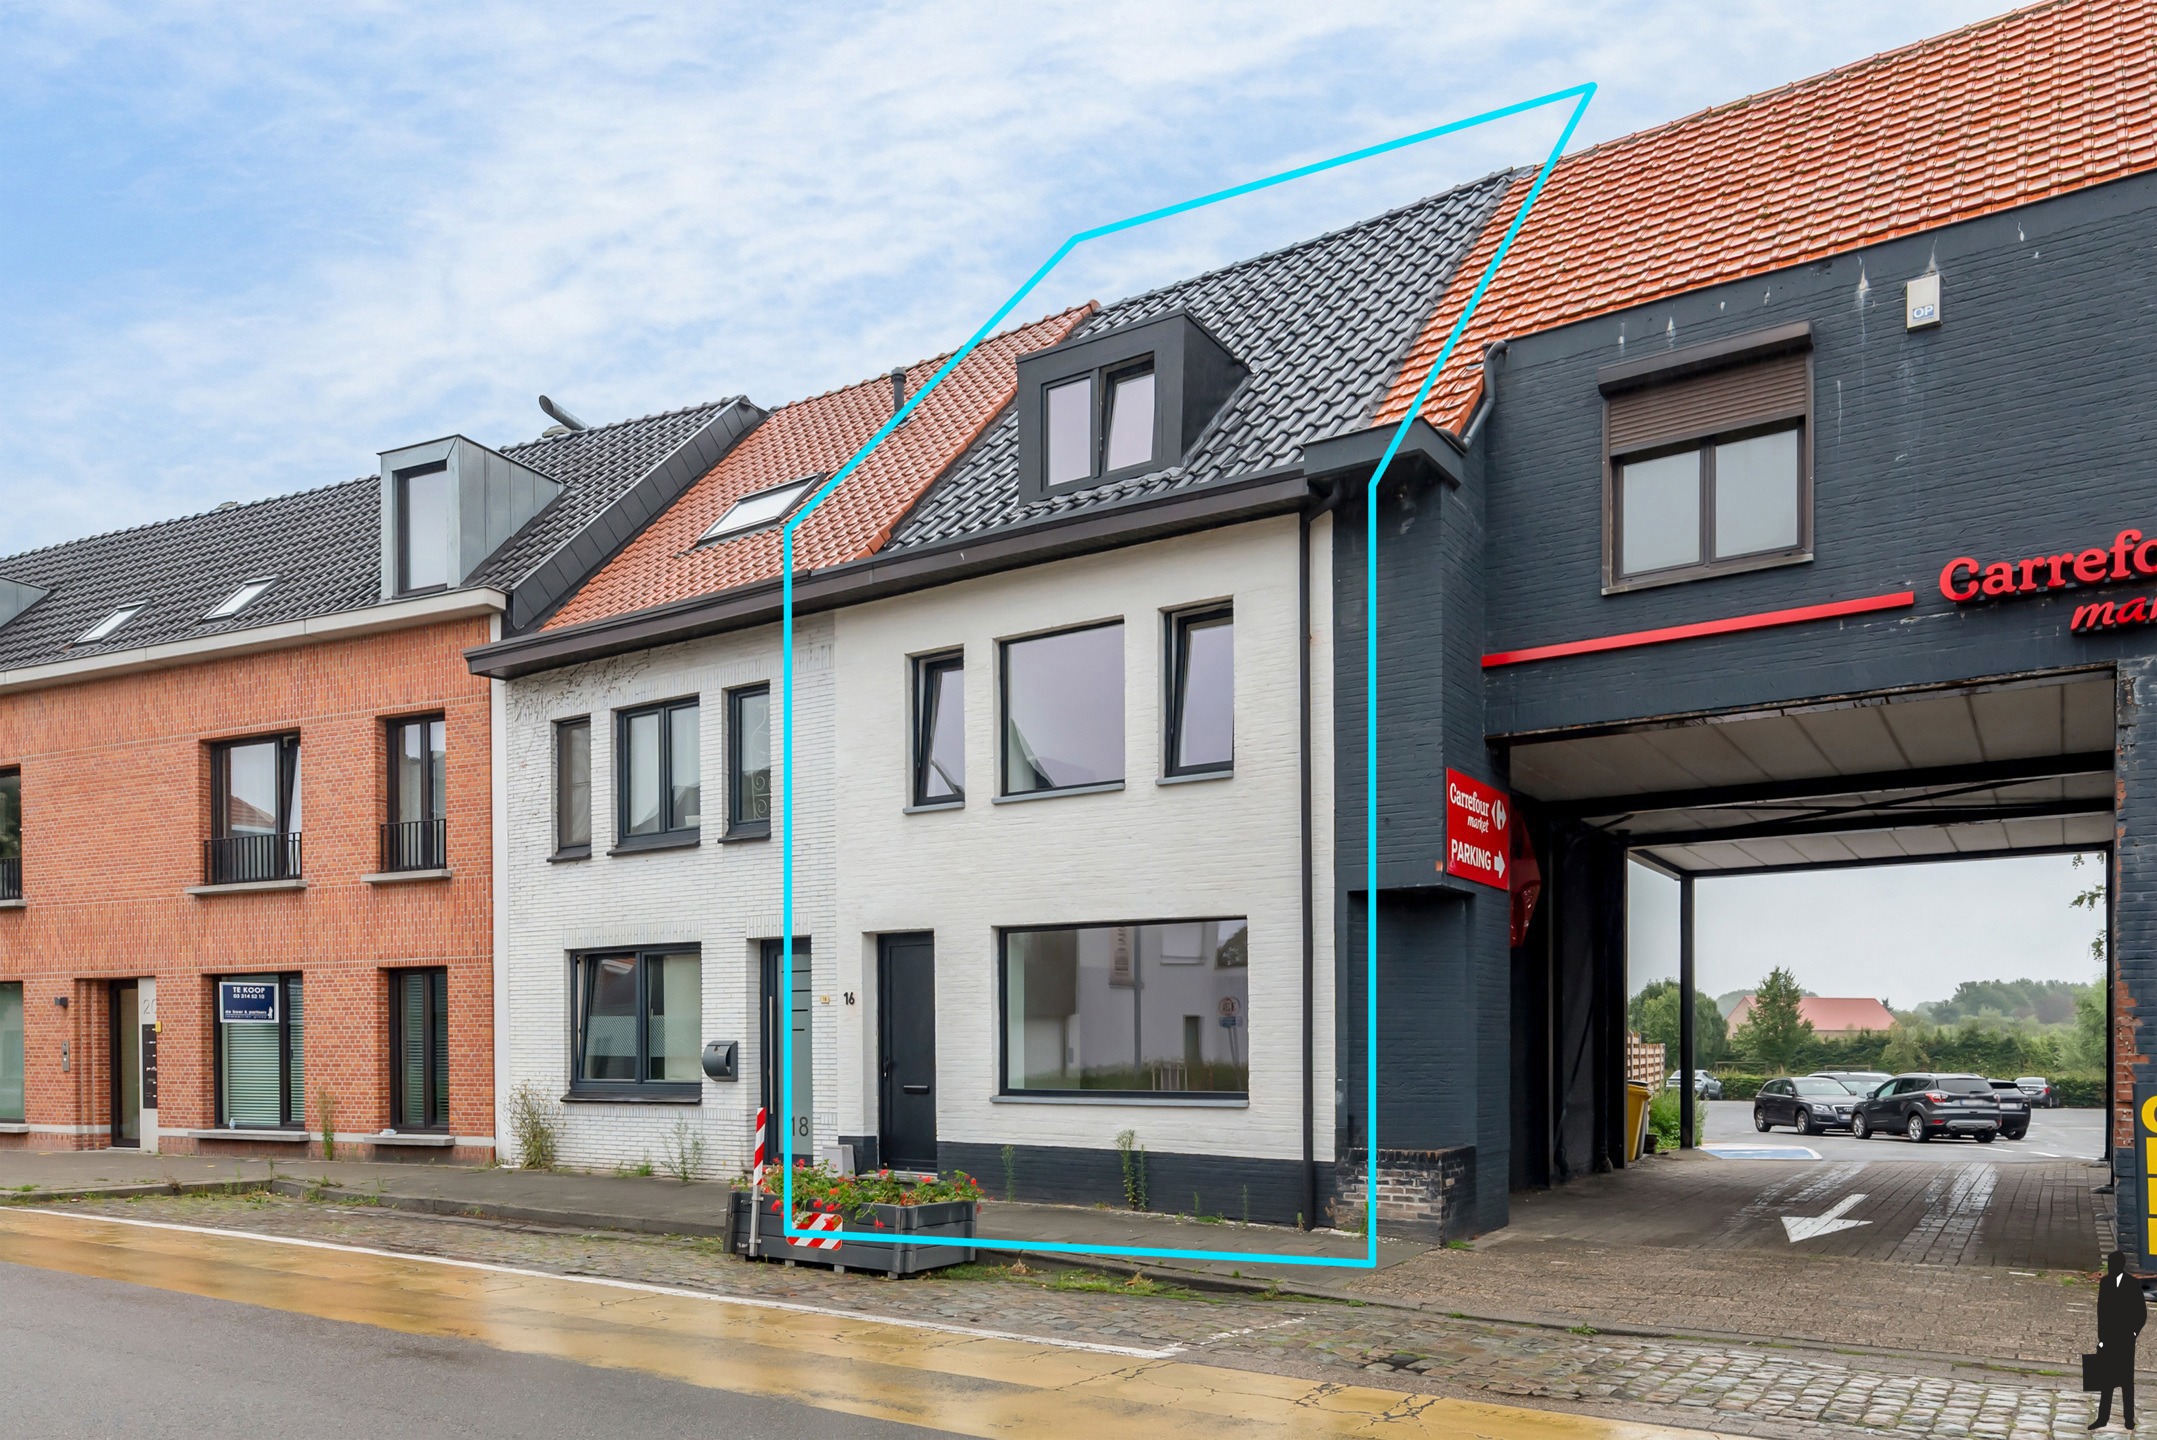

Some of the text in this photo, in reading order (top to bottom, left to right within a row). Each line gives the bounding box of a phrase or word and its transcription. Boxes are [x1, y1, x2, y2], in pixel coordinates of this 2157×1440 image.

[1449, 783, 1490, 817] Carrefour
[1467, 815, 1490, 834] market
[1451, 838, 1492, 871] PARKING
[243, 986, 266, 994] KOOP
[843, 991, 855, 1005] 16
[791, 1115, 809, 1137] 18
